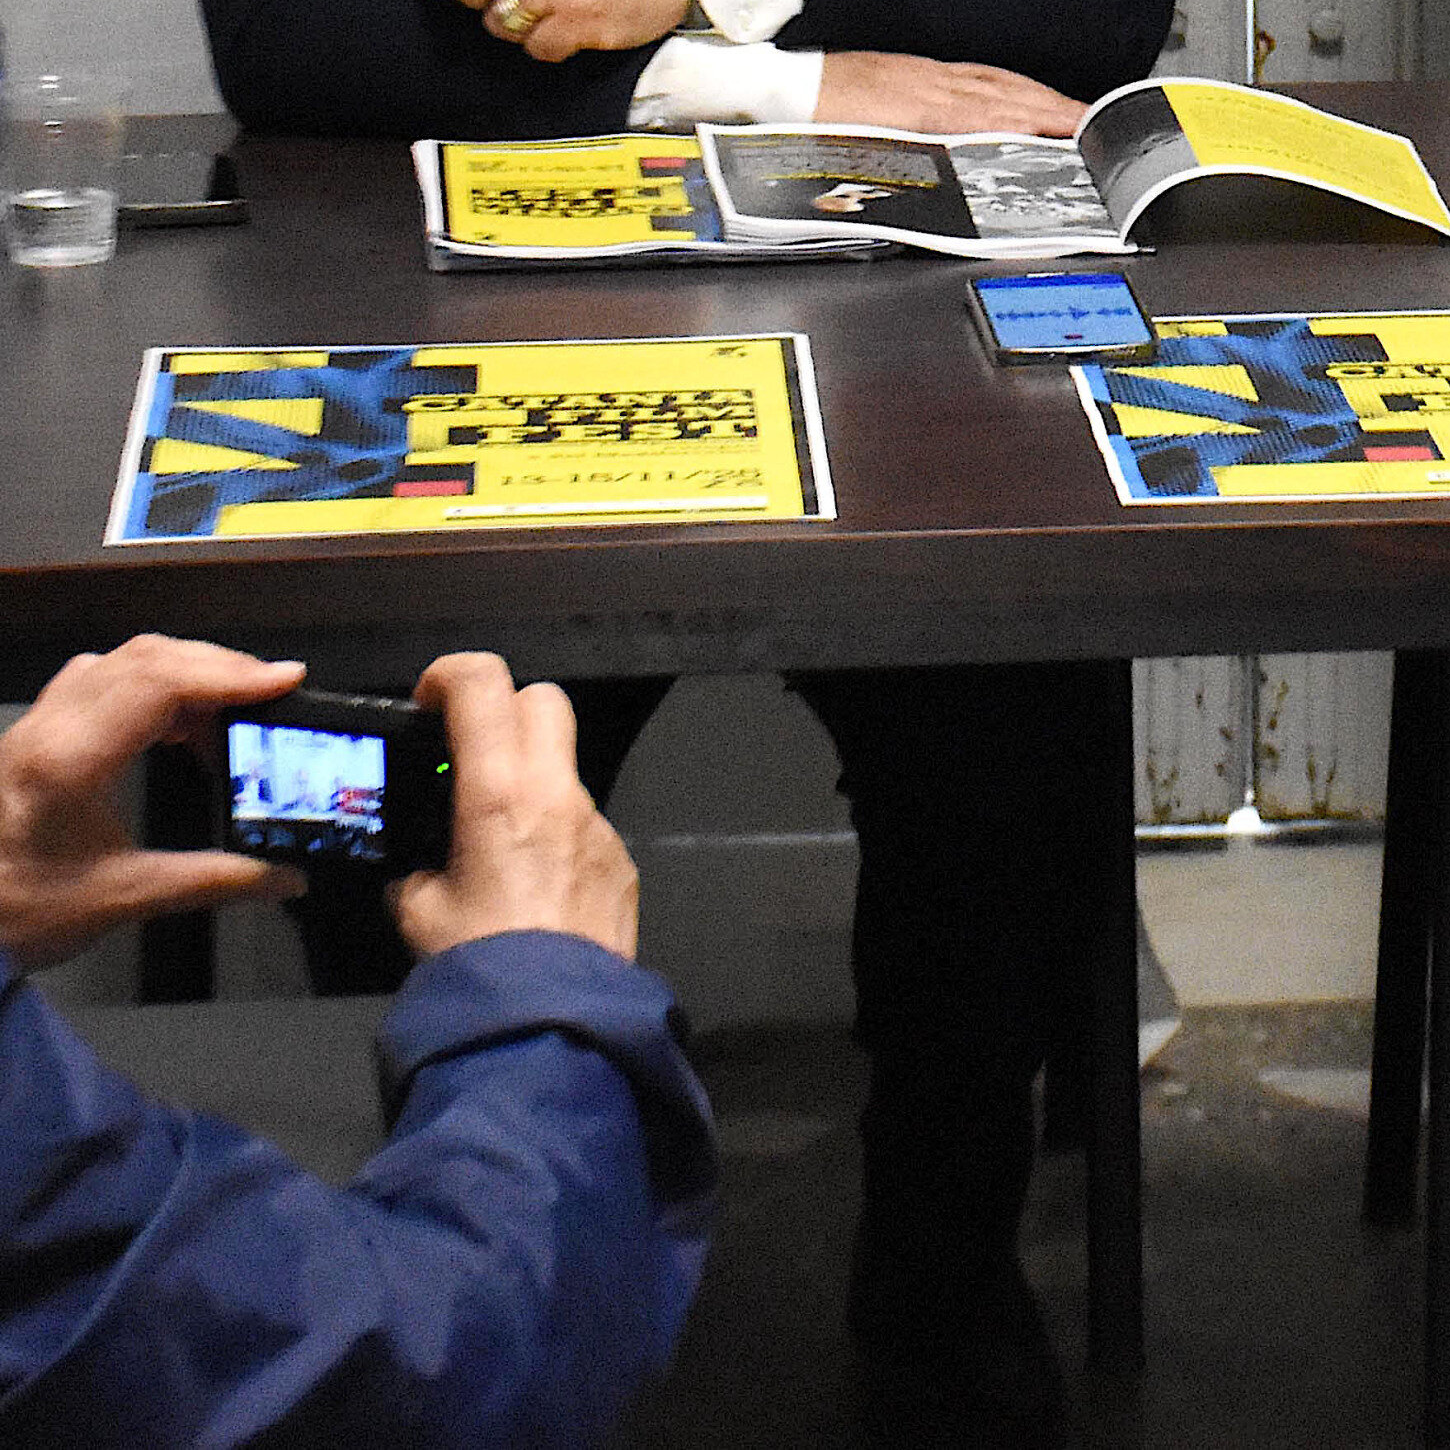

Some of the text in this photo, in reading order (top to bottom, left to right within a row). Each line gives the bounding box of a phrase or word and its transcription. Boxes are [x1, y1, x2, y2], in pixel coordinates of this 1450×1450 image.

[402, 390, 754, 412] CATANIA
[546, 406, 755, 423] FILM
[478, 419, 757, 444] FEST
